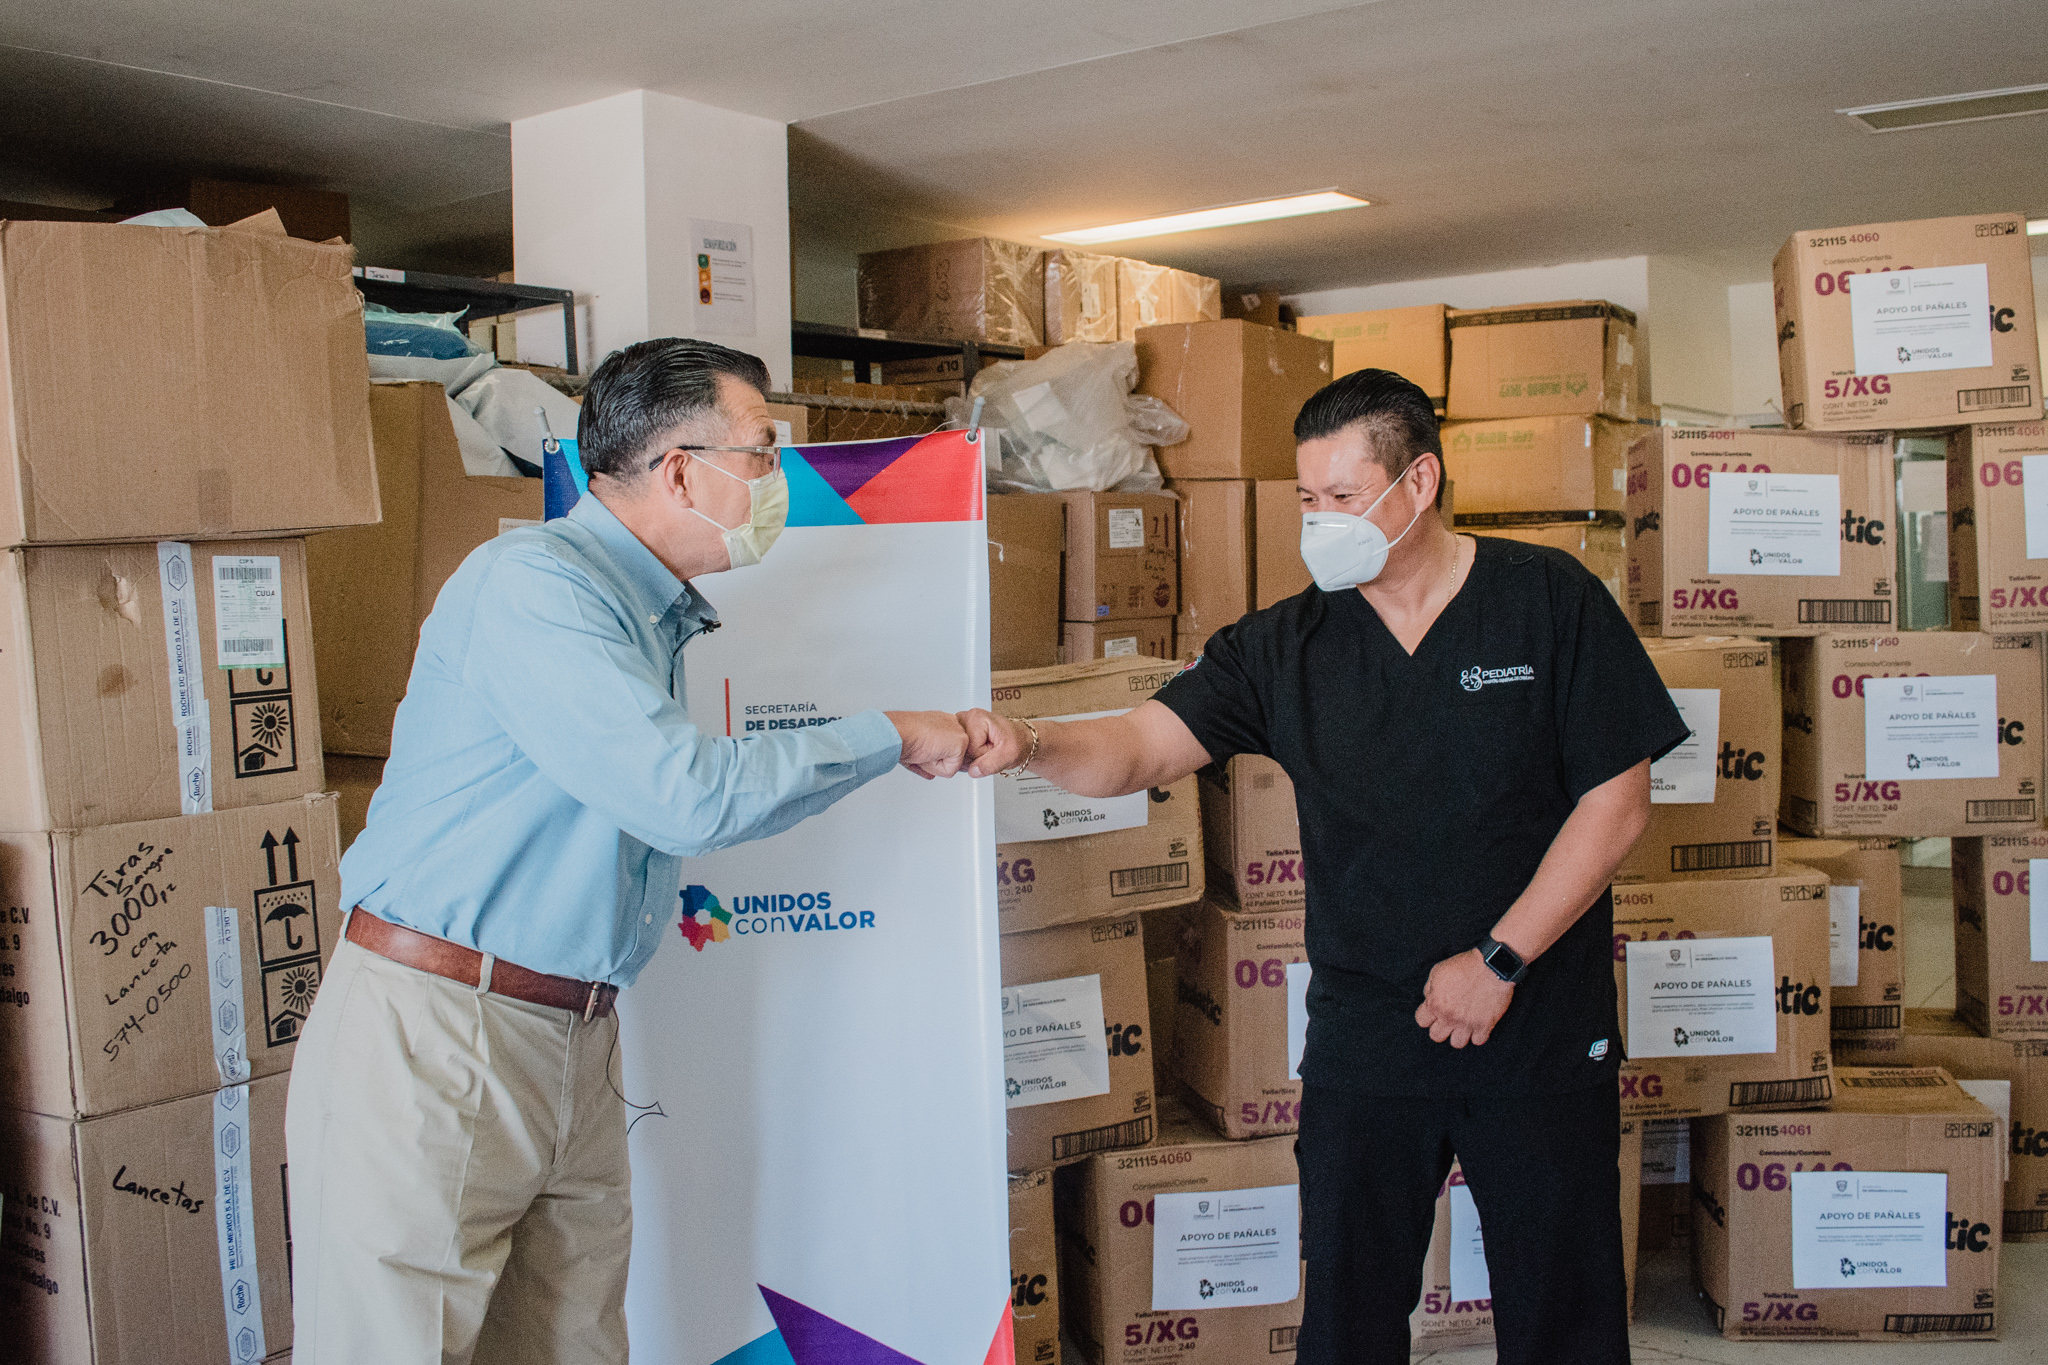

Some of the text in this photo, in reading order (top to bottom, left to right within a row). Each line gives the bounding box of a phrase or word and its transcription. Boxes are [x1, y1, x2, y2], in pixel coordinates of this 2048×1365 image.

[1877, 301, 1968, 315] APOYO DE PAÑALES
[1824, 375, 1892, 399] 5/XG
[1733, 507, 1820, 517] APOYO DE PAÑALES
[1841, 509, 1885, 546] tic
[1673, 588, 1739, 610] 5/XG
[176, 645, 184, 675] MEXICO
[1481, 664, 1535, 680] PEDIATRÍA
[745, 701, 818, 715] SECRETARÍA
[1889, 710, 1977, 721] APOYO DE PAÑALES
[745, 719, 766, 731] DE
[1718, 740, 1765, 782] tic
[1834, 781, 1902, 802] 5/XG
[1059, 809, 1092, 818] UNIDOS
[1060, 813, 1106, 825] conVALOR
[82, 842, 154, 898] Tiras
[1015, 884, 1033, 895] 240
[733, 891, 832, 915] UNIDOS
[89, 882, 160, 956] 3000
[735, 910, 876, 935] conVALOR
[131, 930, 159, 959] con
[104, 940, 178, 1006] Lanceta
[1653, 977, 1752, 990] APOYO DE PAÑALES
[103, 963, 192, 1062] 574-0500
[1998, 994, 2048, 1016] 5/X
[1019, 1026, 1033, 1037] DE
[1035, 1020, 1082, 1034] PAÑALES
[1021, 1076, 1053, 1088] UNIDOS
[112, 1164, 205, 1215] Lancetas
[1819, 1209, 1921, 1220] APOYO DE PAÑALES
[225, 1213, 234, 1243] MEXICO
[1180, 1227, 1277, 1242] APOYO DE PAÑALES
[1214, 1280, 1245, 1288] UNIDOS
[236, 1283, 245, 1310] Roche
[1475, 1316, 1492, 1326] 240
[1742, 1301, 1819, 1322] 5/XG
[1125, 1316, 1200, 1347] 5/XG
[1178, 1341, 1196, 1352] 240
